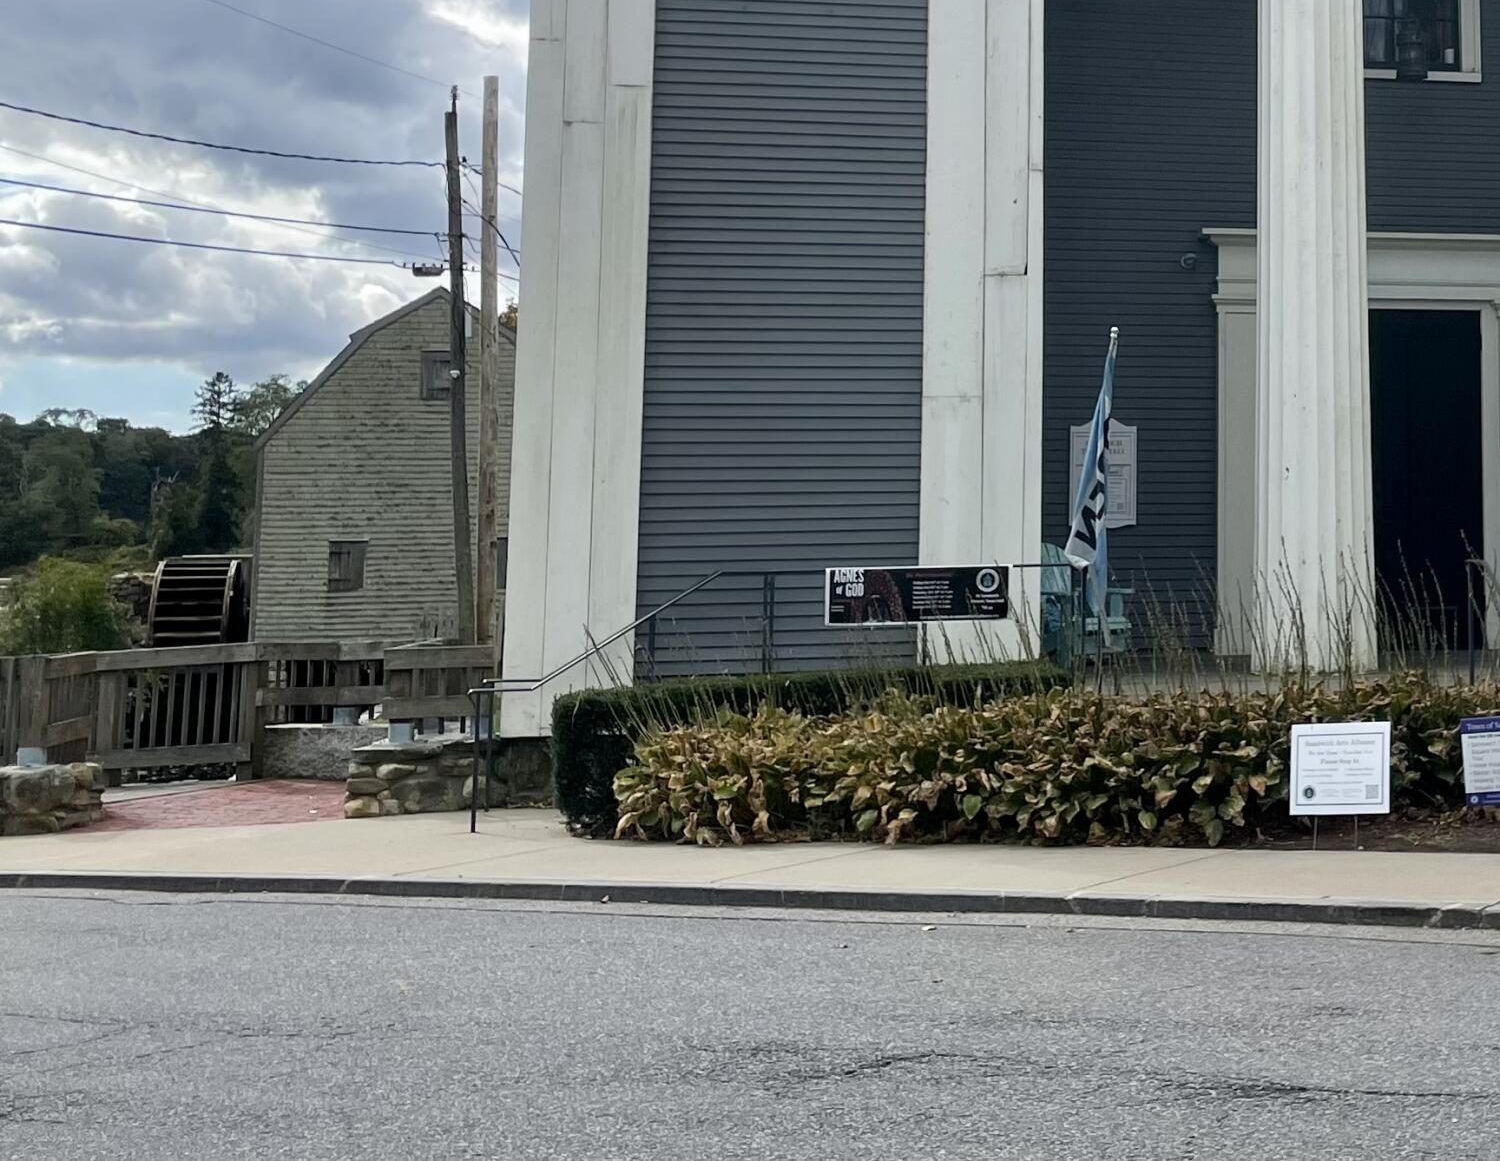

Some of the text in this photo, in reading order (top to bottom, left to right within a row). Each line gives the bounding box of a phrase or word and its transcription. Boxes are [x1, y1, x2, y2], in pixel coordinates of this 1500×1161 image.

[833, 569, 865, 584] AGNES
[845, 583, 865, 597] GOD
[1466, 723, 1486, 732] Town
